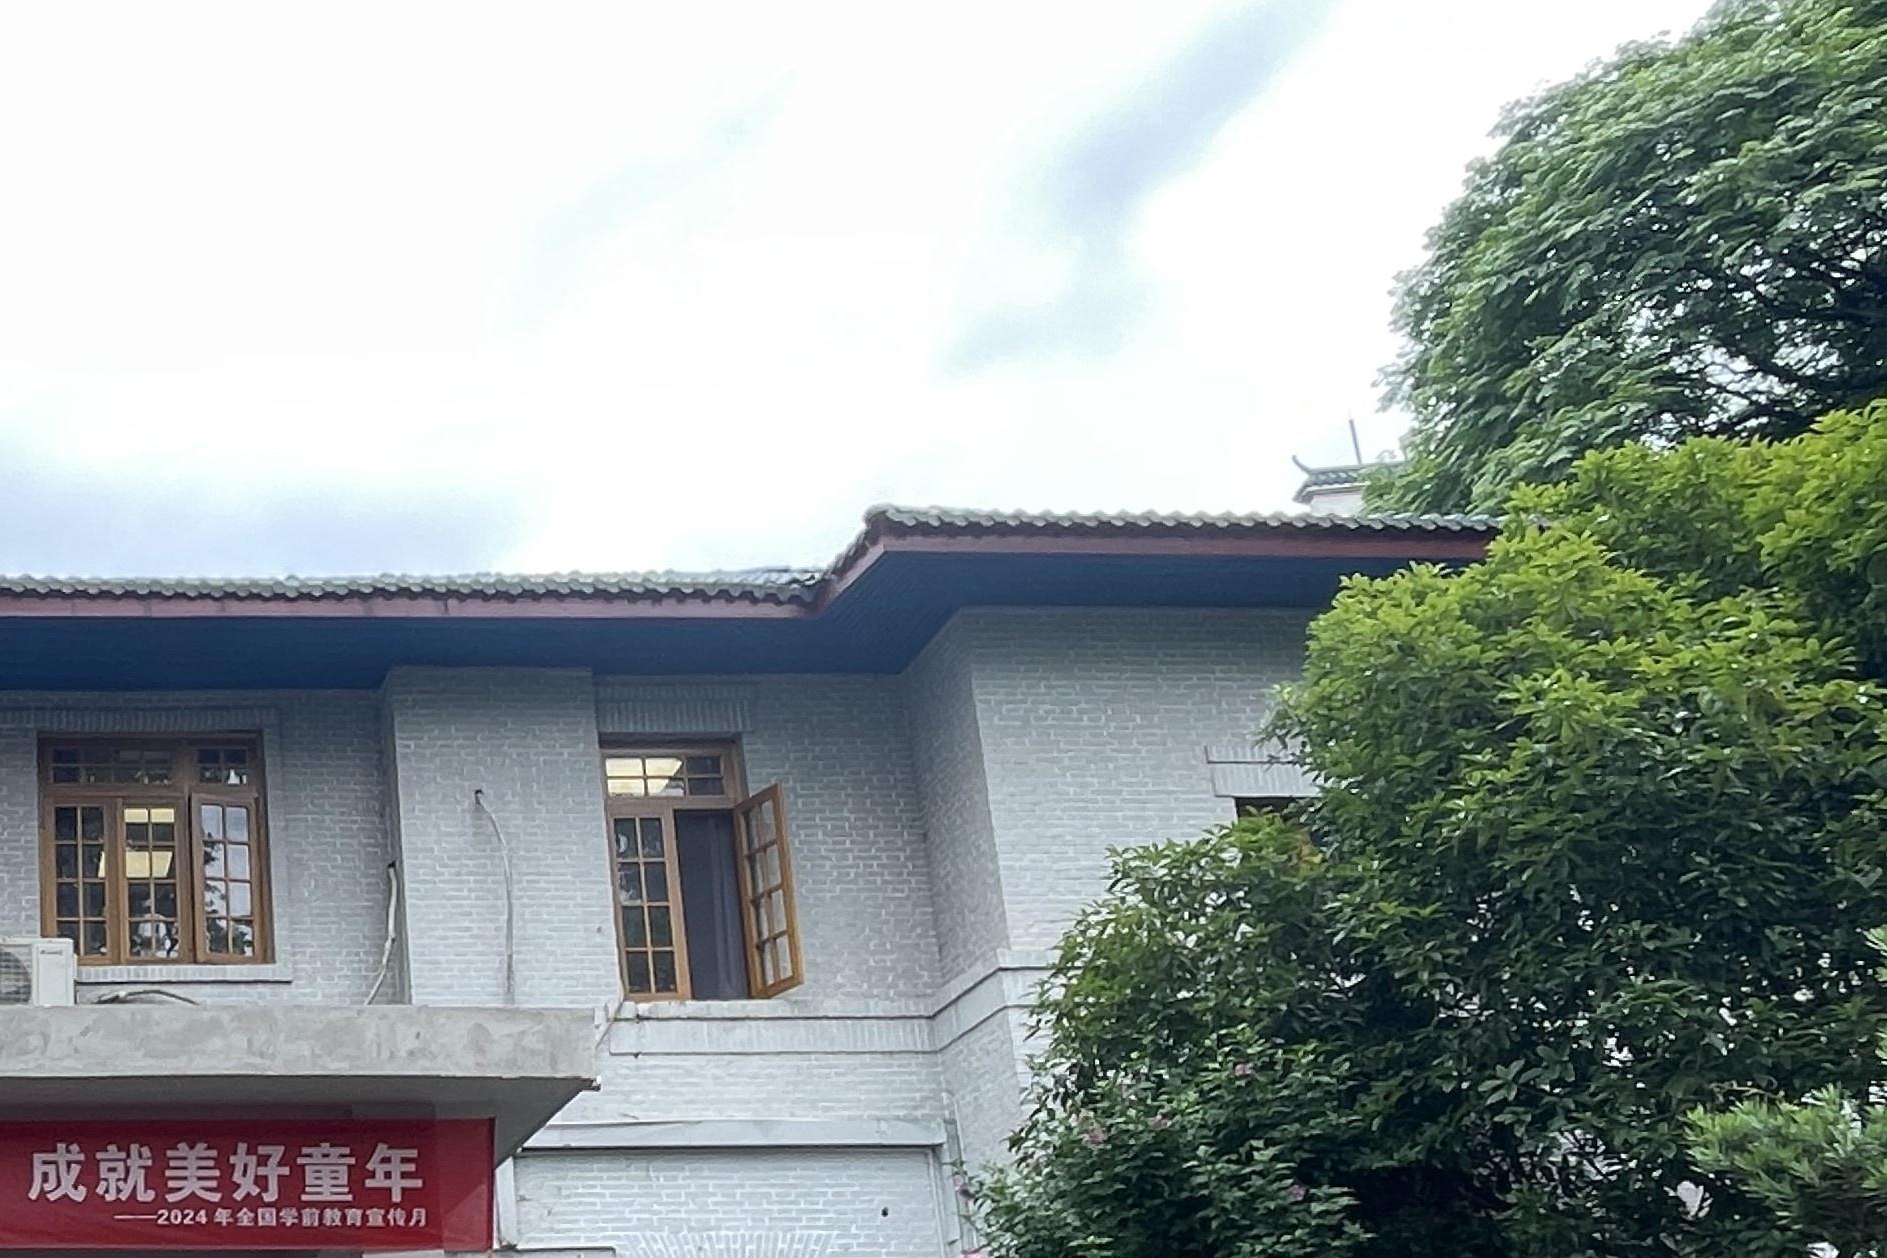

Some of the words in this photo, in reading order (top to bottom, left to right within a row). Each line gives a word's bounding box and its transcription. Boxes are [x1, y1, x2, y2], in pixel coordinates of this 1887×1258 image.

[27, 1142, 424, 1203] 成就美好童年
